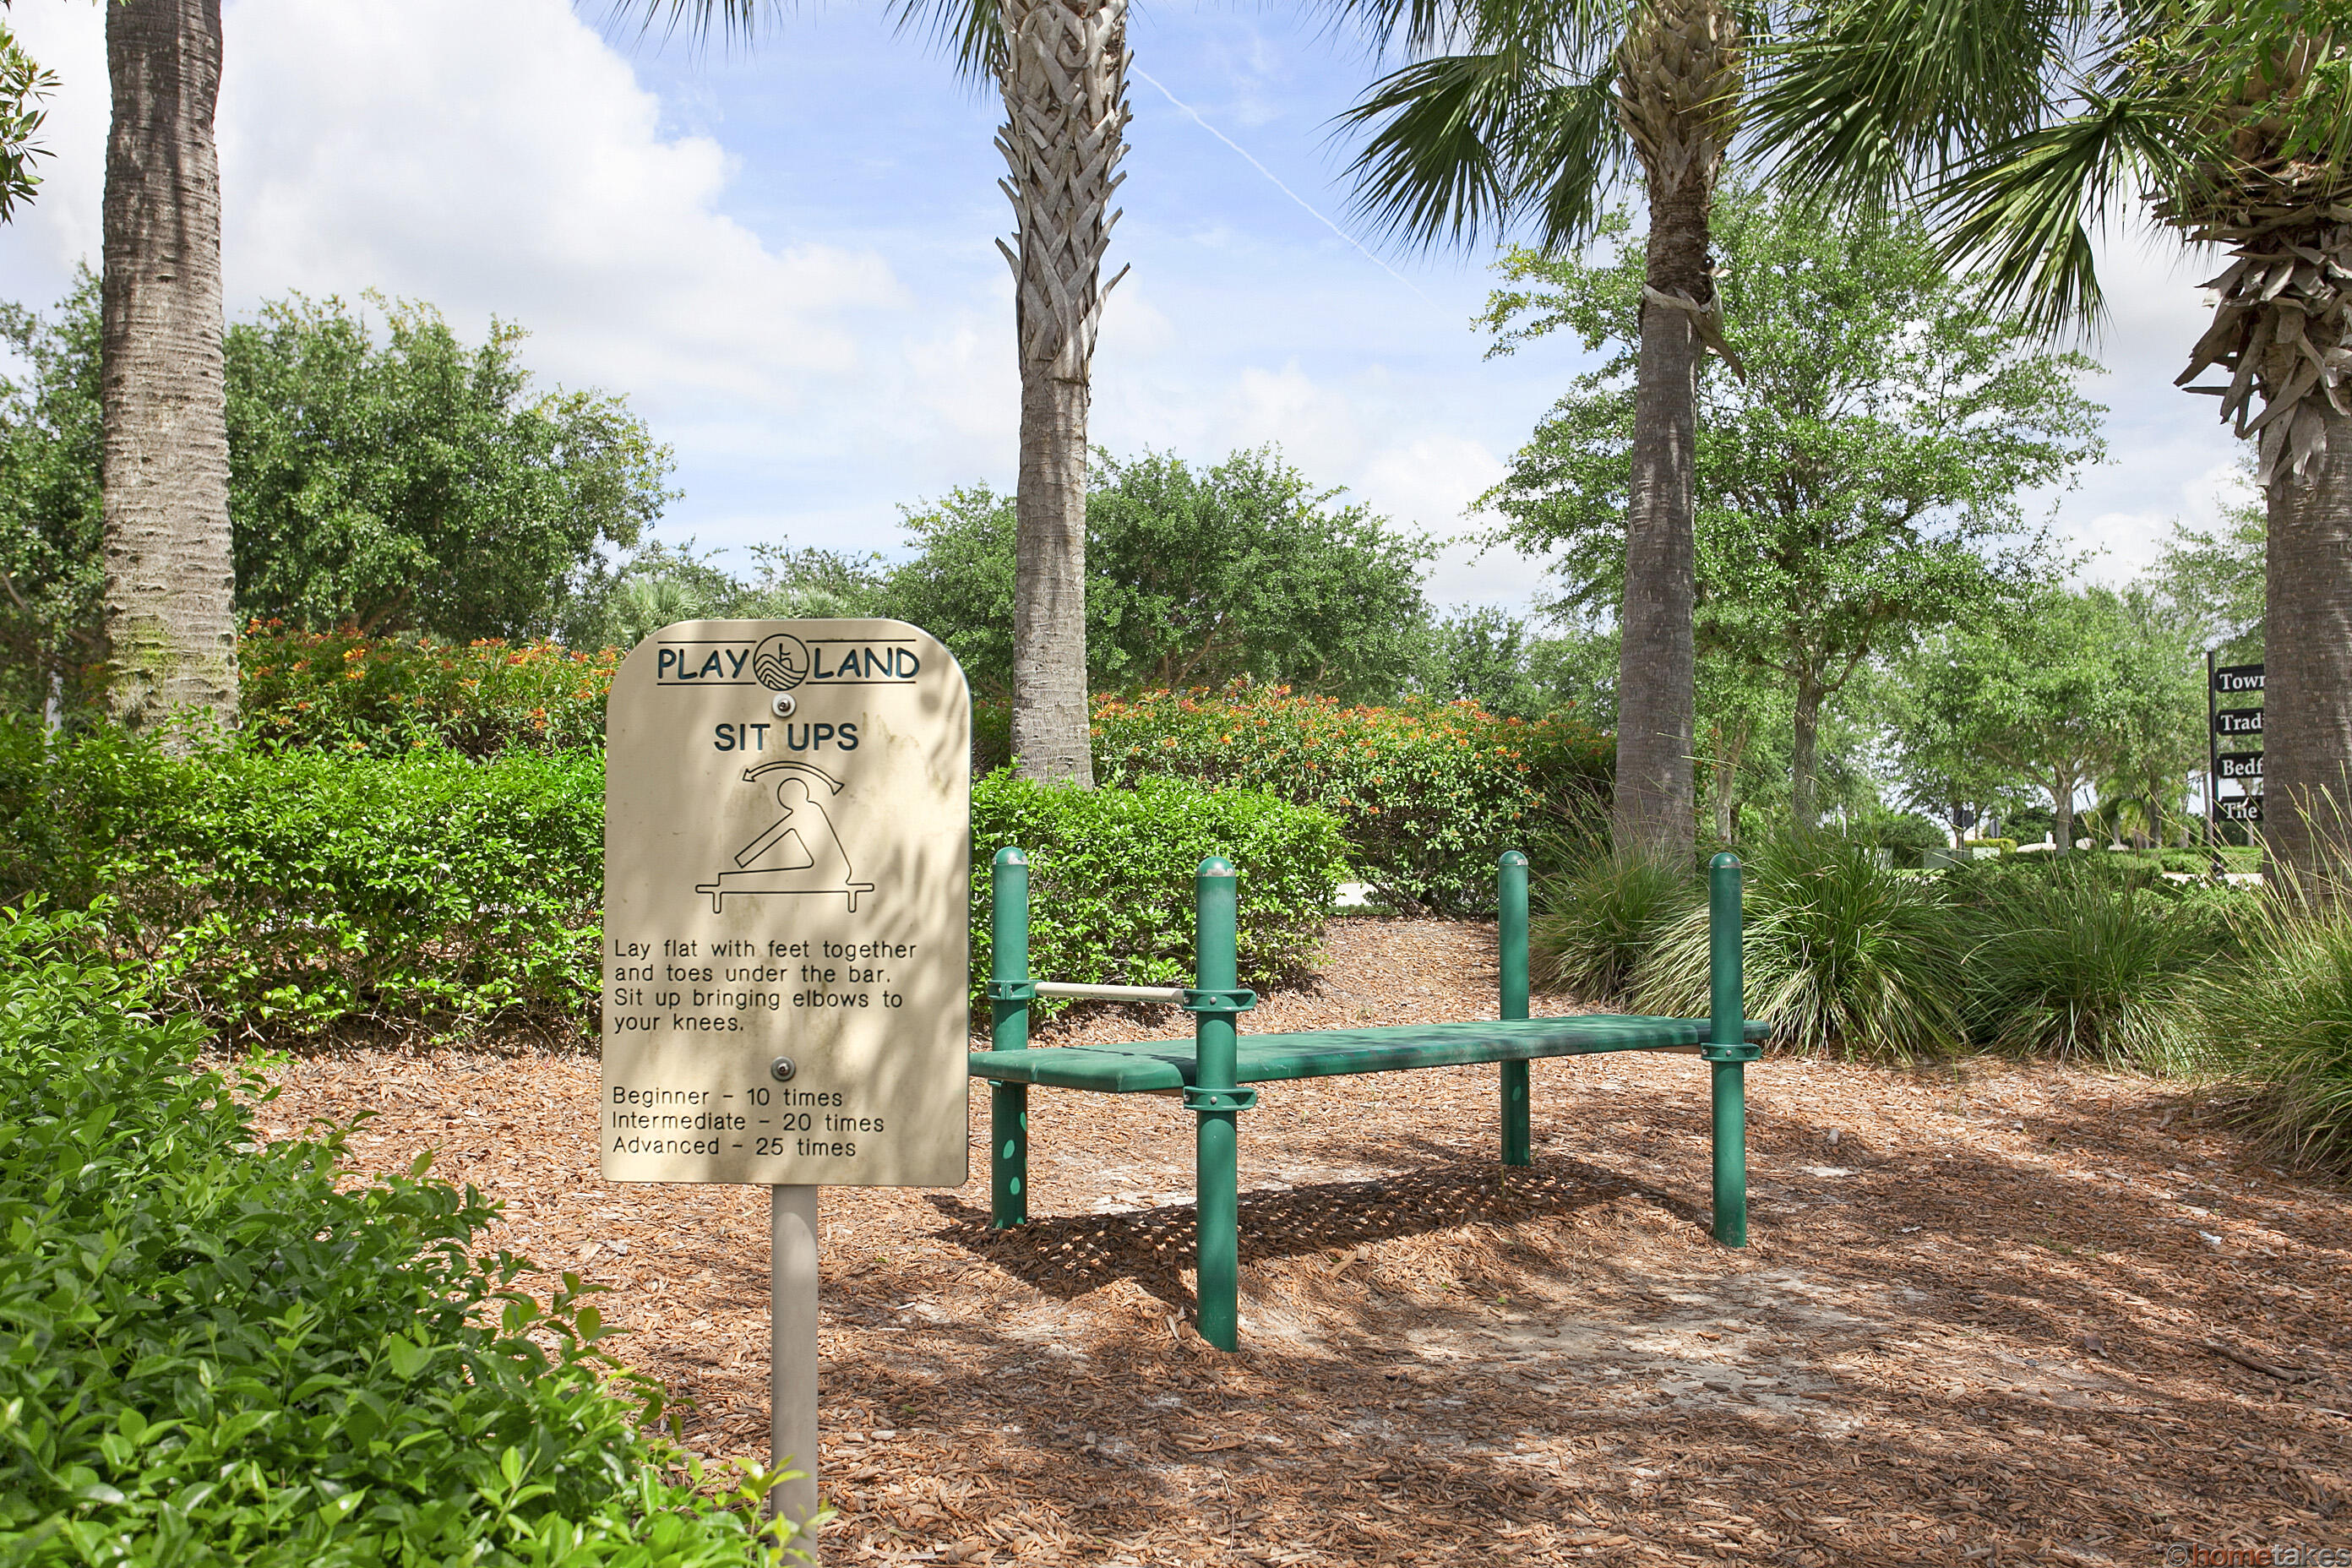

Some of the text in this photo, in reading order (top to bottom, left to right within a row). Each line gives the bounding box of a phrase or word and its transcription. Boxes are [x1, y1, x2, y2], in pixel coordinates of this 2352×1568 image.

[657, 646, 921, 680] PLAY LAND
[2220, 712, 2264, 731] Trad
[713, 722, 859, 752] SIT UPS
[2223, 802, 2258, 819] The
[614, 939, 917, 961] Lay flat with feet together
[614, 963, 890, 983] and toes under the bar.
[614, 987, 903, 1010] Sit up bringing elbows to
[614, 1012, 744, 1035] your knees.
[612, 1086, 710, 1108] Beginner
[746, 1087, 770, 1107] 10
[783, 1088, 843, 1108] times
[612, 1110, 746, 1130] Intermediate
[783, 1113, 812, 1132] 20
[825, 1113, 885, 1133] times
[612, 1135, 720, 1155] Advanced
[755, 1136, 784, 1156] 25
[797, 1137, 857, 1157] times
